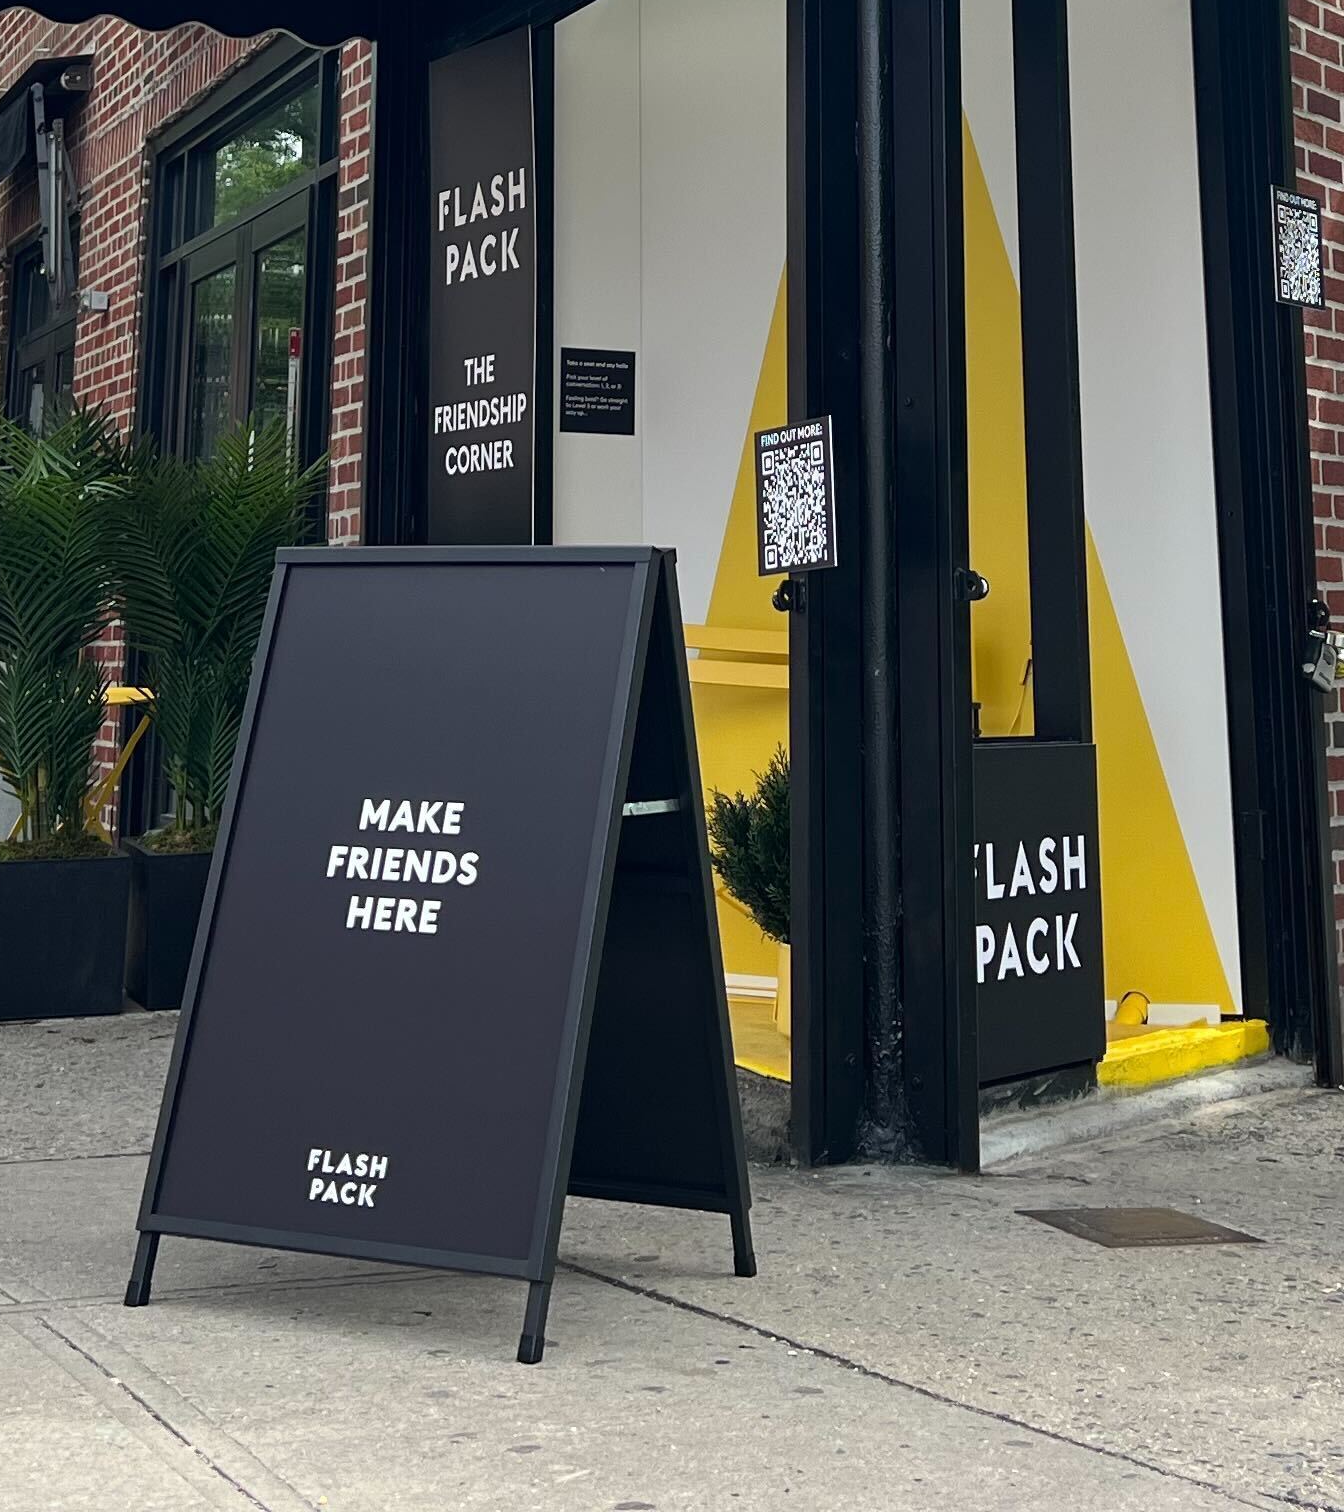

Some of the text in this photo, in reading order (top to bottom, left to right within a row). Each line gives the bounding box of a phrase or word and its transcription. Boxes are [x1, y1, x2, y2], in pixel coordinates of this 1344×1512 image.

[438, 168, 526, 231] FLASH
[446, 228, 520, 285] PACK
[464, 354, 495, 386] THE
[434, 393, 527, 434] FRIENDSHIP
[761, 433, 779, 447] FIND
[780, 428, 796, 443] OUT
[445, 439, 514, 475] CORNER
[359, 799, 464, 835] MAKE
[326, 846, 479, 886] FRIENDS
[346, 896, 441, 934] HERE
[976, 913, 1081, 983] PACK
[308, 1149, 388, 1179] FLASH
[309, 1178, 376, 1207] PACK
